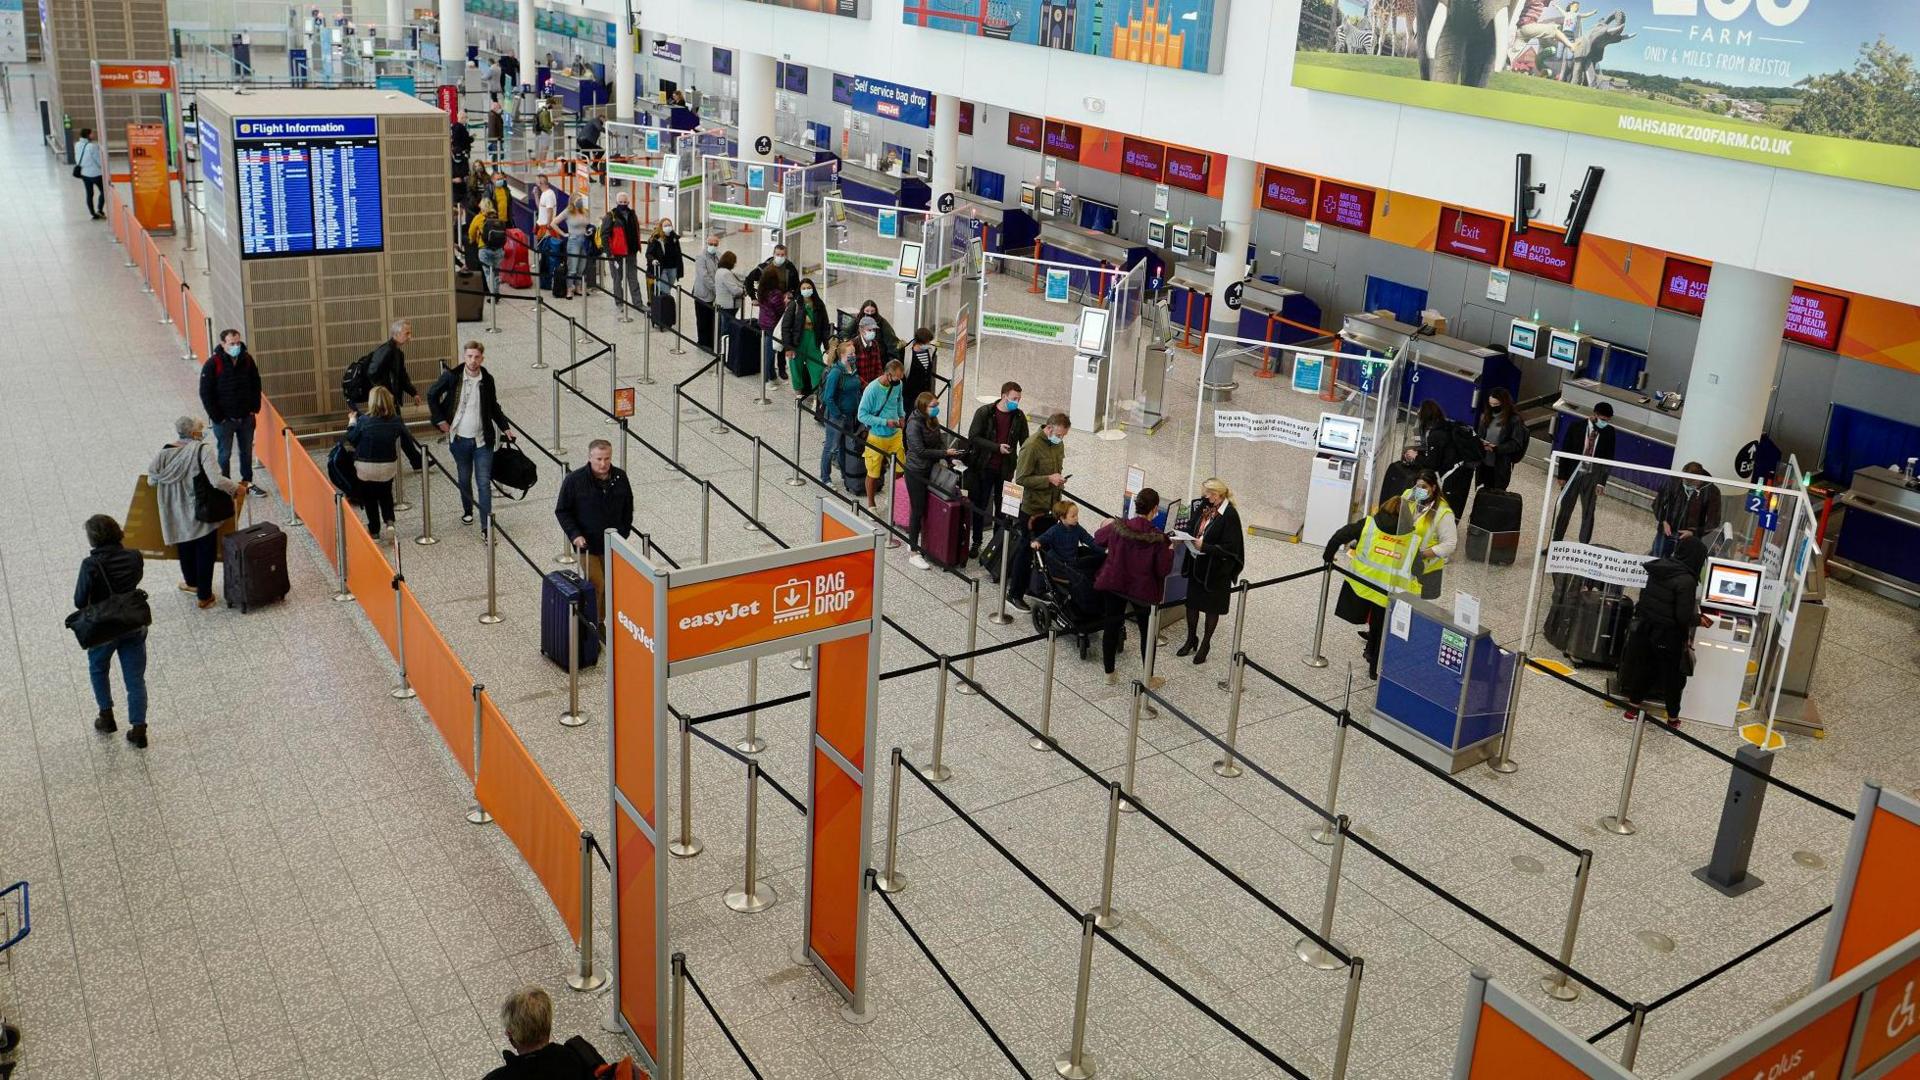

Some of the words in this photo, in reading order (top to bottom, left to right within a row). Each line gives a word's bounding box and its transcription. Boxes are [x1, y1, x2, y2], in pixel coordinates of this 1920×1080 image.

[1689, 25, 1752, 46] FARM
[1644, 46, 1667, 62] ONLY
[1671, 51, 1677, 64] 6
[1681, 51, 1711, 68] MILES
[1716, 53, 1745, 72] FROM
[1747, 57, 1792, 78] BRISTOL
[854, 78, 868, 92] Self
[869, 85, 894, 99] service
[895, 88, 908, 105] bag
[910, 92, 927, 109] drop
[252, 123, 284, 136] Flight
[285, 122, 345, 133] Information
[1618, 114, 1793, 156] NOAHSARKZOOFARM.CO.UK
[970, 220, 978, 228] 12
[1460, 224, 1480, 240] Exit
[1530, 245, 1550, 256] AUTO
[1528, 252, 1544, 263] BAG
[1544, 256, 1566, 267] DROP
[1152, 279, 1158, 288] 9
[1689, 280, 1708, 291] AUT
[1806, 298, 1819, 308] YOU
[1803, 317, 1826, 329] HEALTH
[1362, 364, 1367, 375] 5
[1412, 371, 1419, 383] 6
[1361, 380, 1369, 391] 4
[1271, 426, 1301, 437] distancing
[1750, 497, 1761, 512] 2
[1765, 513, 1772, 528] 1
[1561, 555, 1603, 569] respecting
[1605, 564, 1629, 573] social
[1583, 549, 1602, 560] keep
[1604, 555, 1621, 564] you,
[1623, 558, 1637, 566] and
[815, 571, 845, 596] BAG
[814, 589, 855, 616] DROP
[679, 600, 760, 630] easyJet
[617, 610, 655, 654] easyJet
[1767, 1049, 1803, 1080] plus
